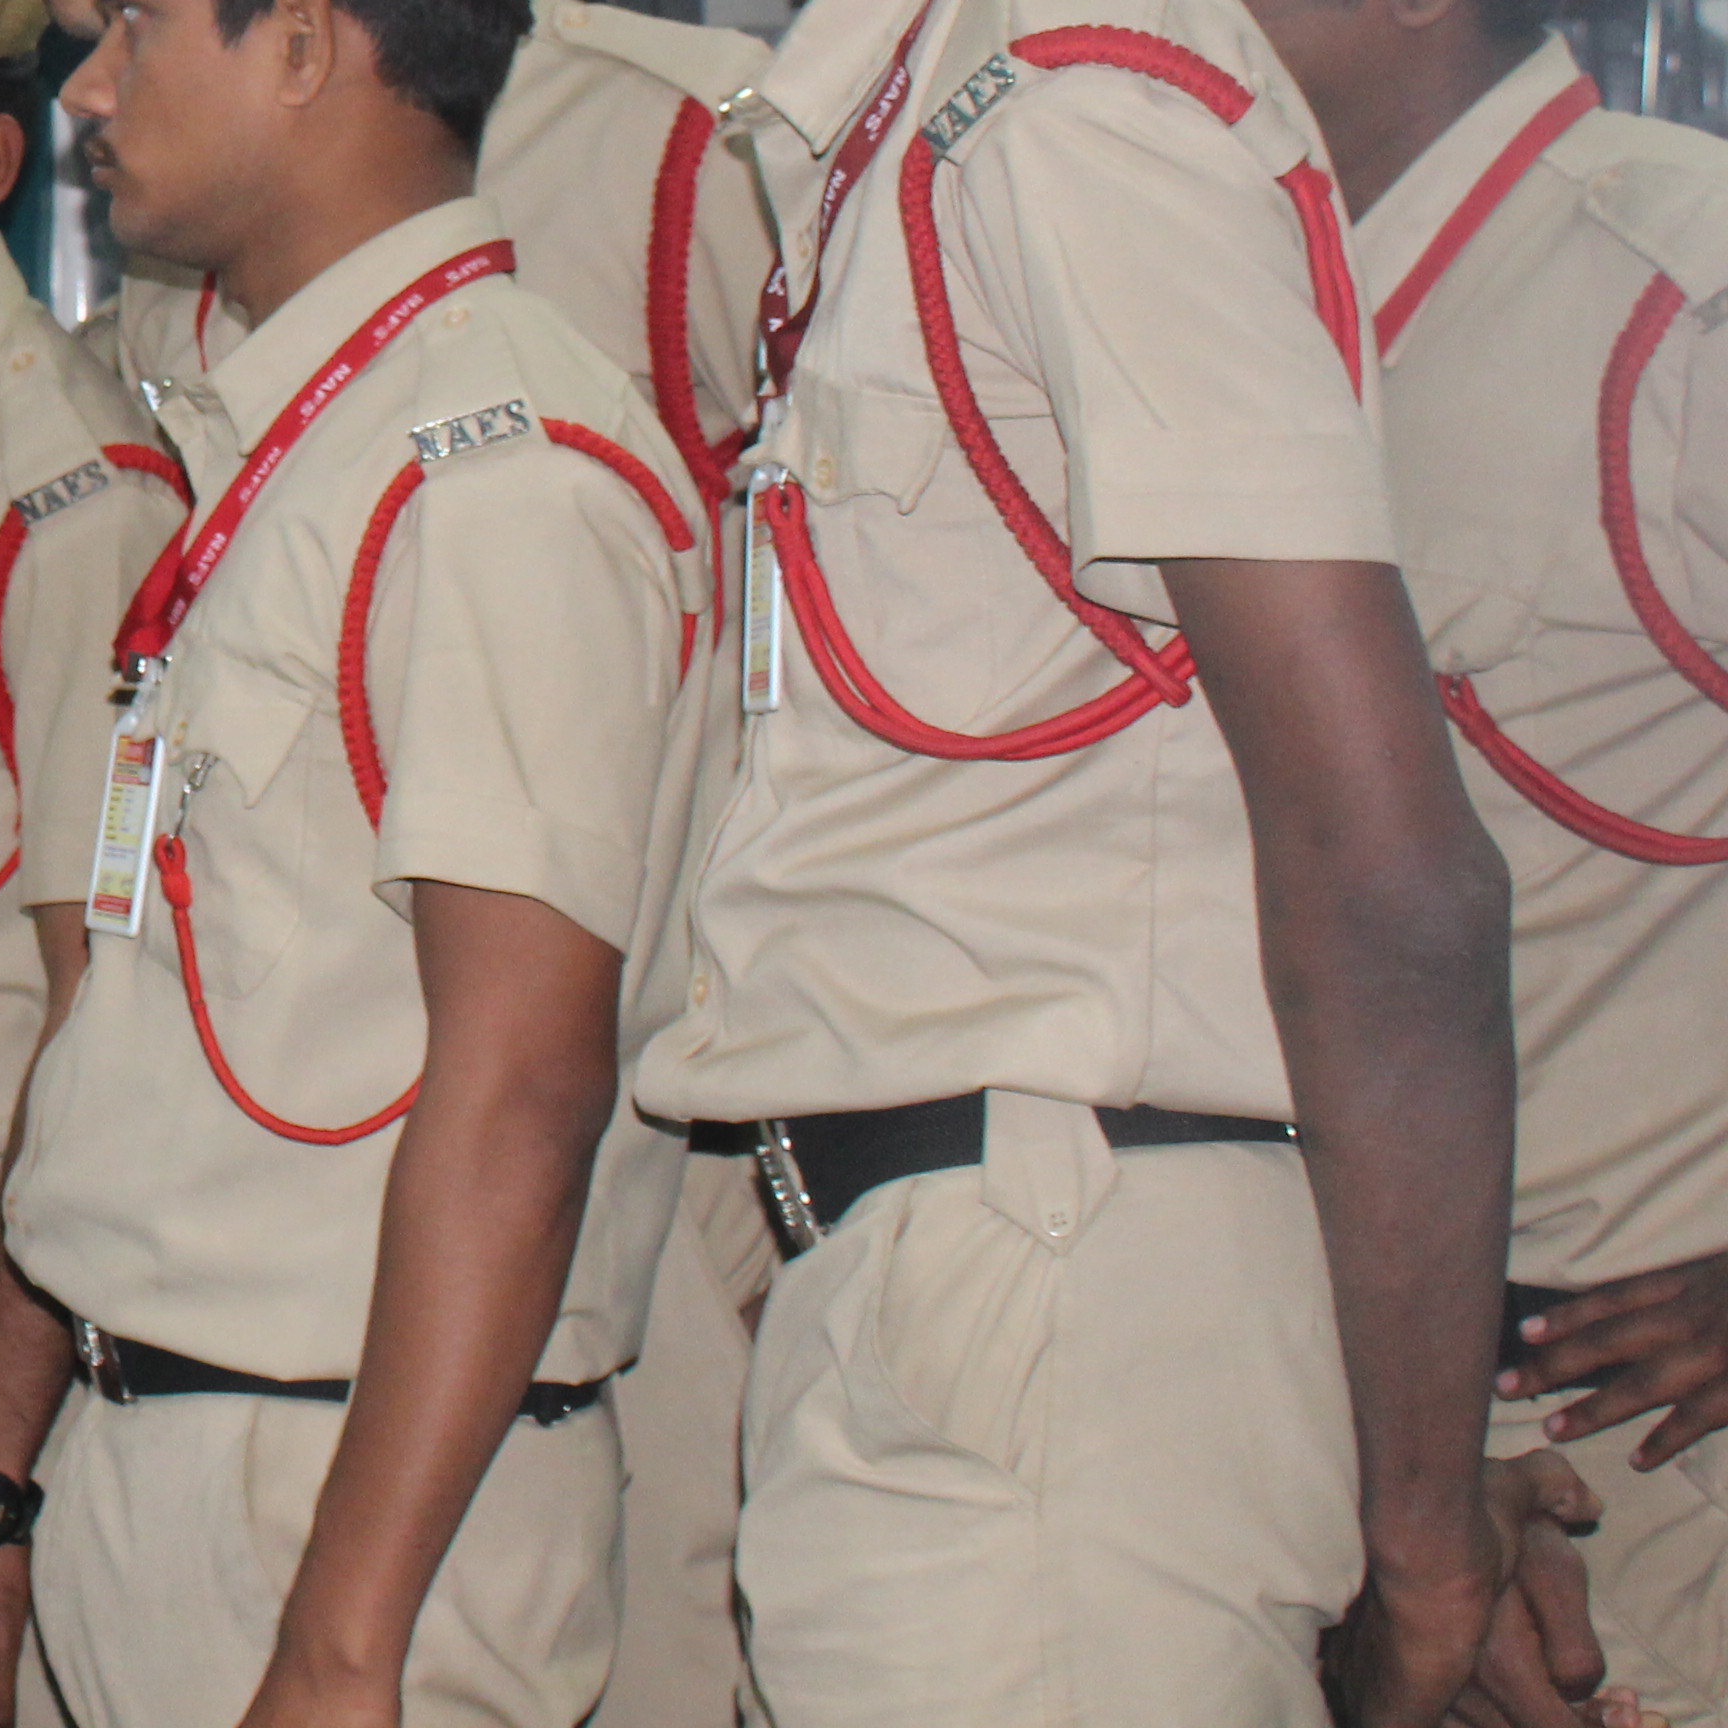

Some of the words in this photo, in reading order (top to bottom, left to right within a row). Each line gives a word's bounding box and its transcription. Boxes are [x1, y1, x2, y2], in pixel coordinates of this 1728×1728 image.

[864, 66, 908, 133] NAFS
[920, 53, 1016, 151] NAFS
[373, 292, 425, 340] NAFS
[300, 363, 352, 418] NAFS
[409, 398, 530, 464] NAFS
[10, 458, 109, 526] NAFS
[238, 446, 282, 504] NAFS
[187, 531, 227, 587] NAFS
